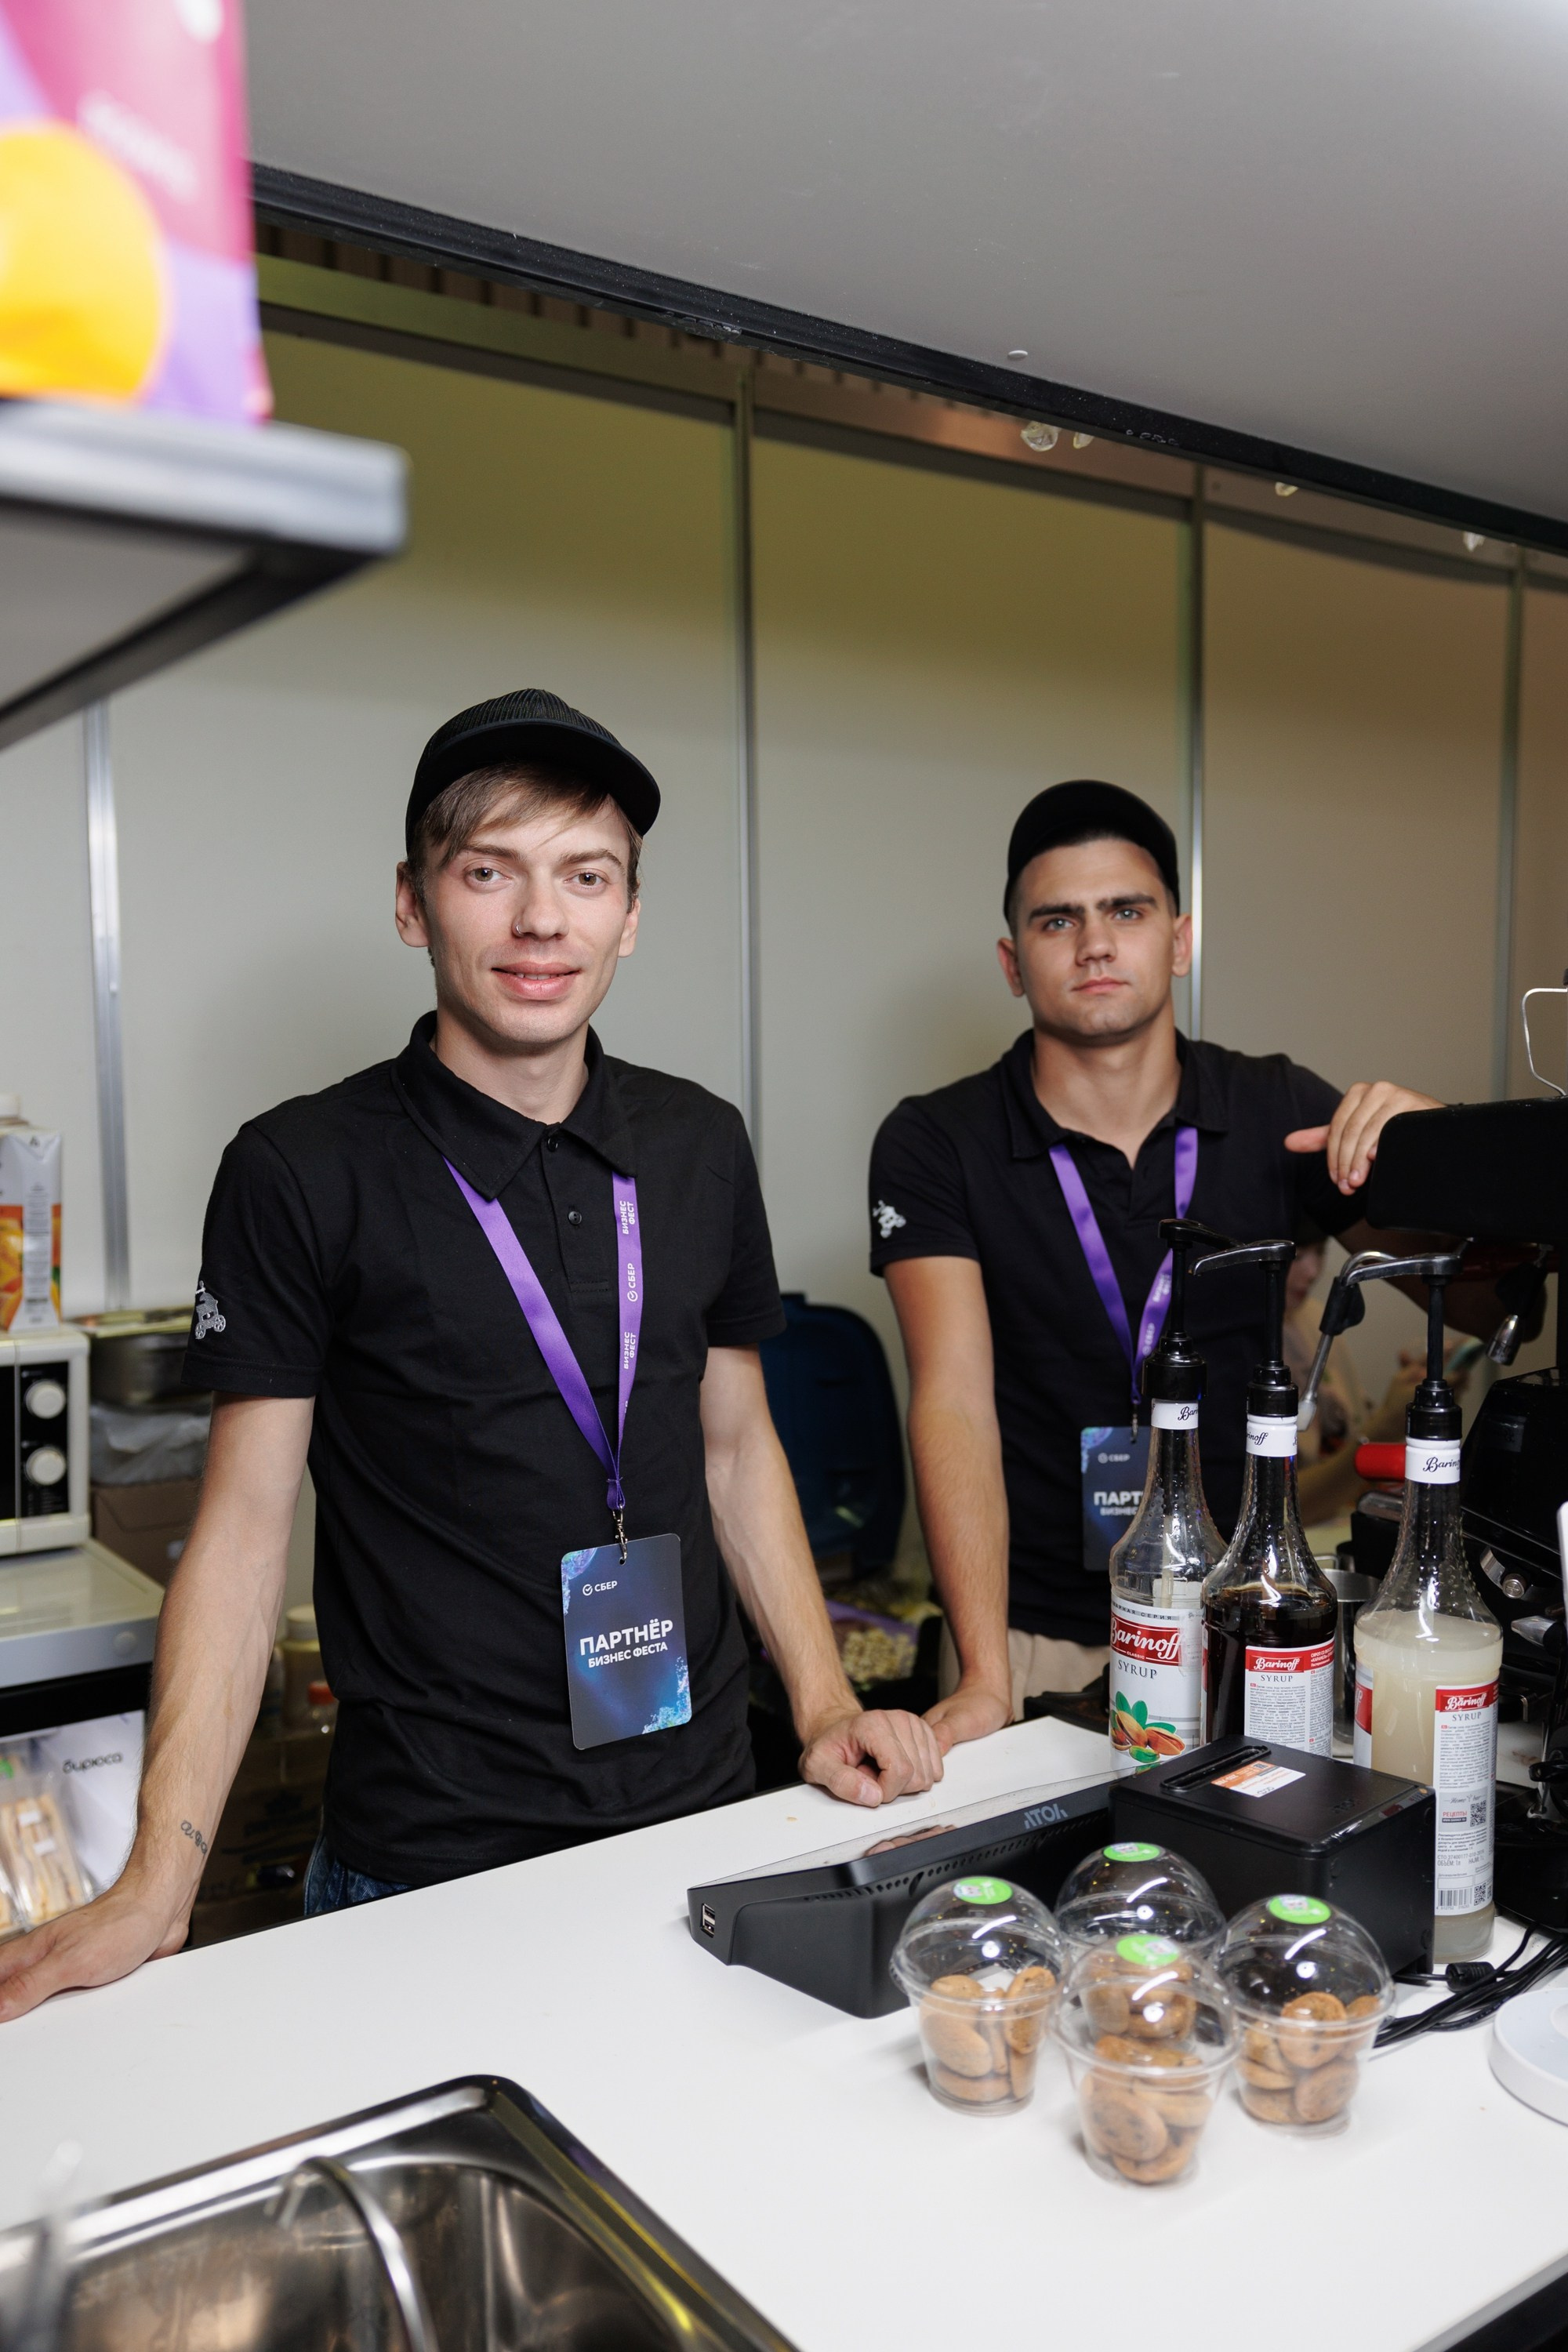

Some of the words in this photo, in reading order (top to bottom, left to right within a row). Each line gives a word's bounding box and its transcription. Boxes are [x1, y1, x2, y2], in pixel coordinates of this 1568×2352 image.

[619, 1200, 630, 1235] БИЗНЕС
[627, 1201, 636, 1225] ФЕСТ
[627, 1262, 637, 1289] СБЕР
[1093, 1490, 1144, 1506] ПАРТ
[593, 1580, 618, 1592] СБЕР
[1141, 1612, 1172, 1621] СЕРИЯ
[579, 1618, 673, 1656] ПАРТНЁР
[1110, 1617, 1182, 1660] Barinoff
[588, 1650, 632, 1668] БИЗНЕС
[633, 1641, 668, 1657] ФЕСТА
[1126, 1650, 1145, 1660] CLASSIC
[1253, 1657, 1300, 1671] Barinoff
[1117, 1659, 1158, 1679] SYRUP
[1260, 1674, 1293, 1682] SYRUP
[1444, 1692, 1487, 1711] Barinoff
[1452, 1711, 1482, 1722] SYRUP
